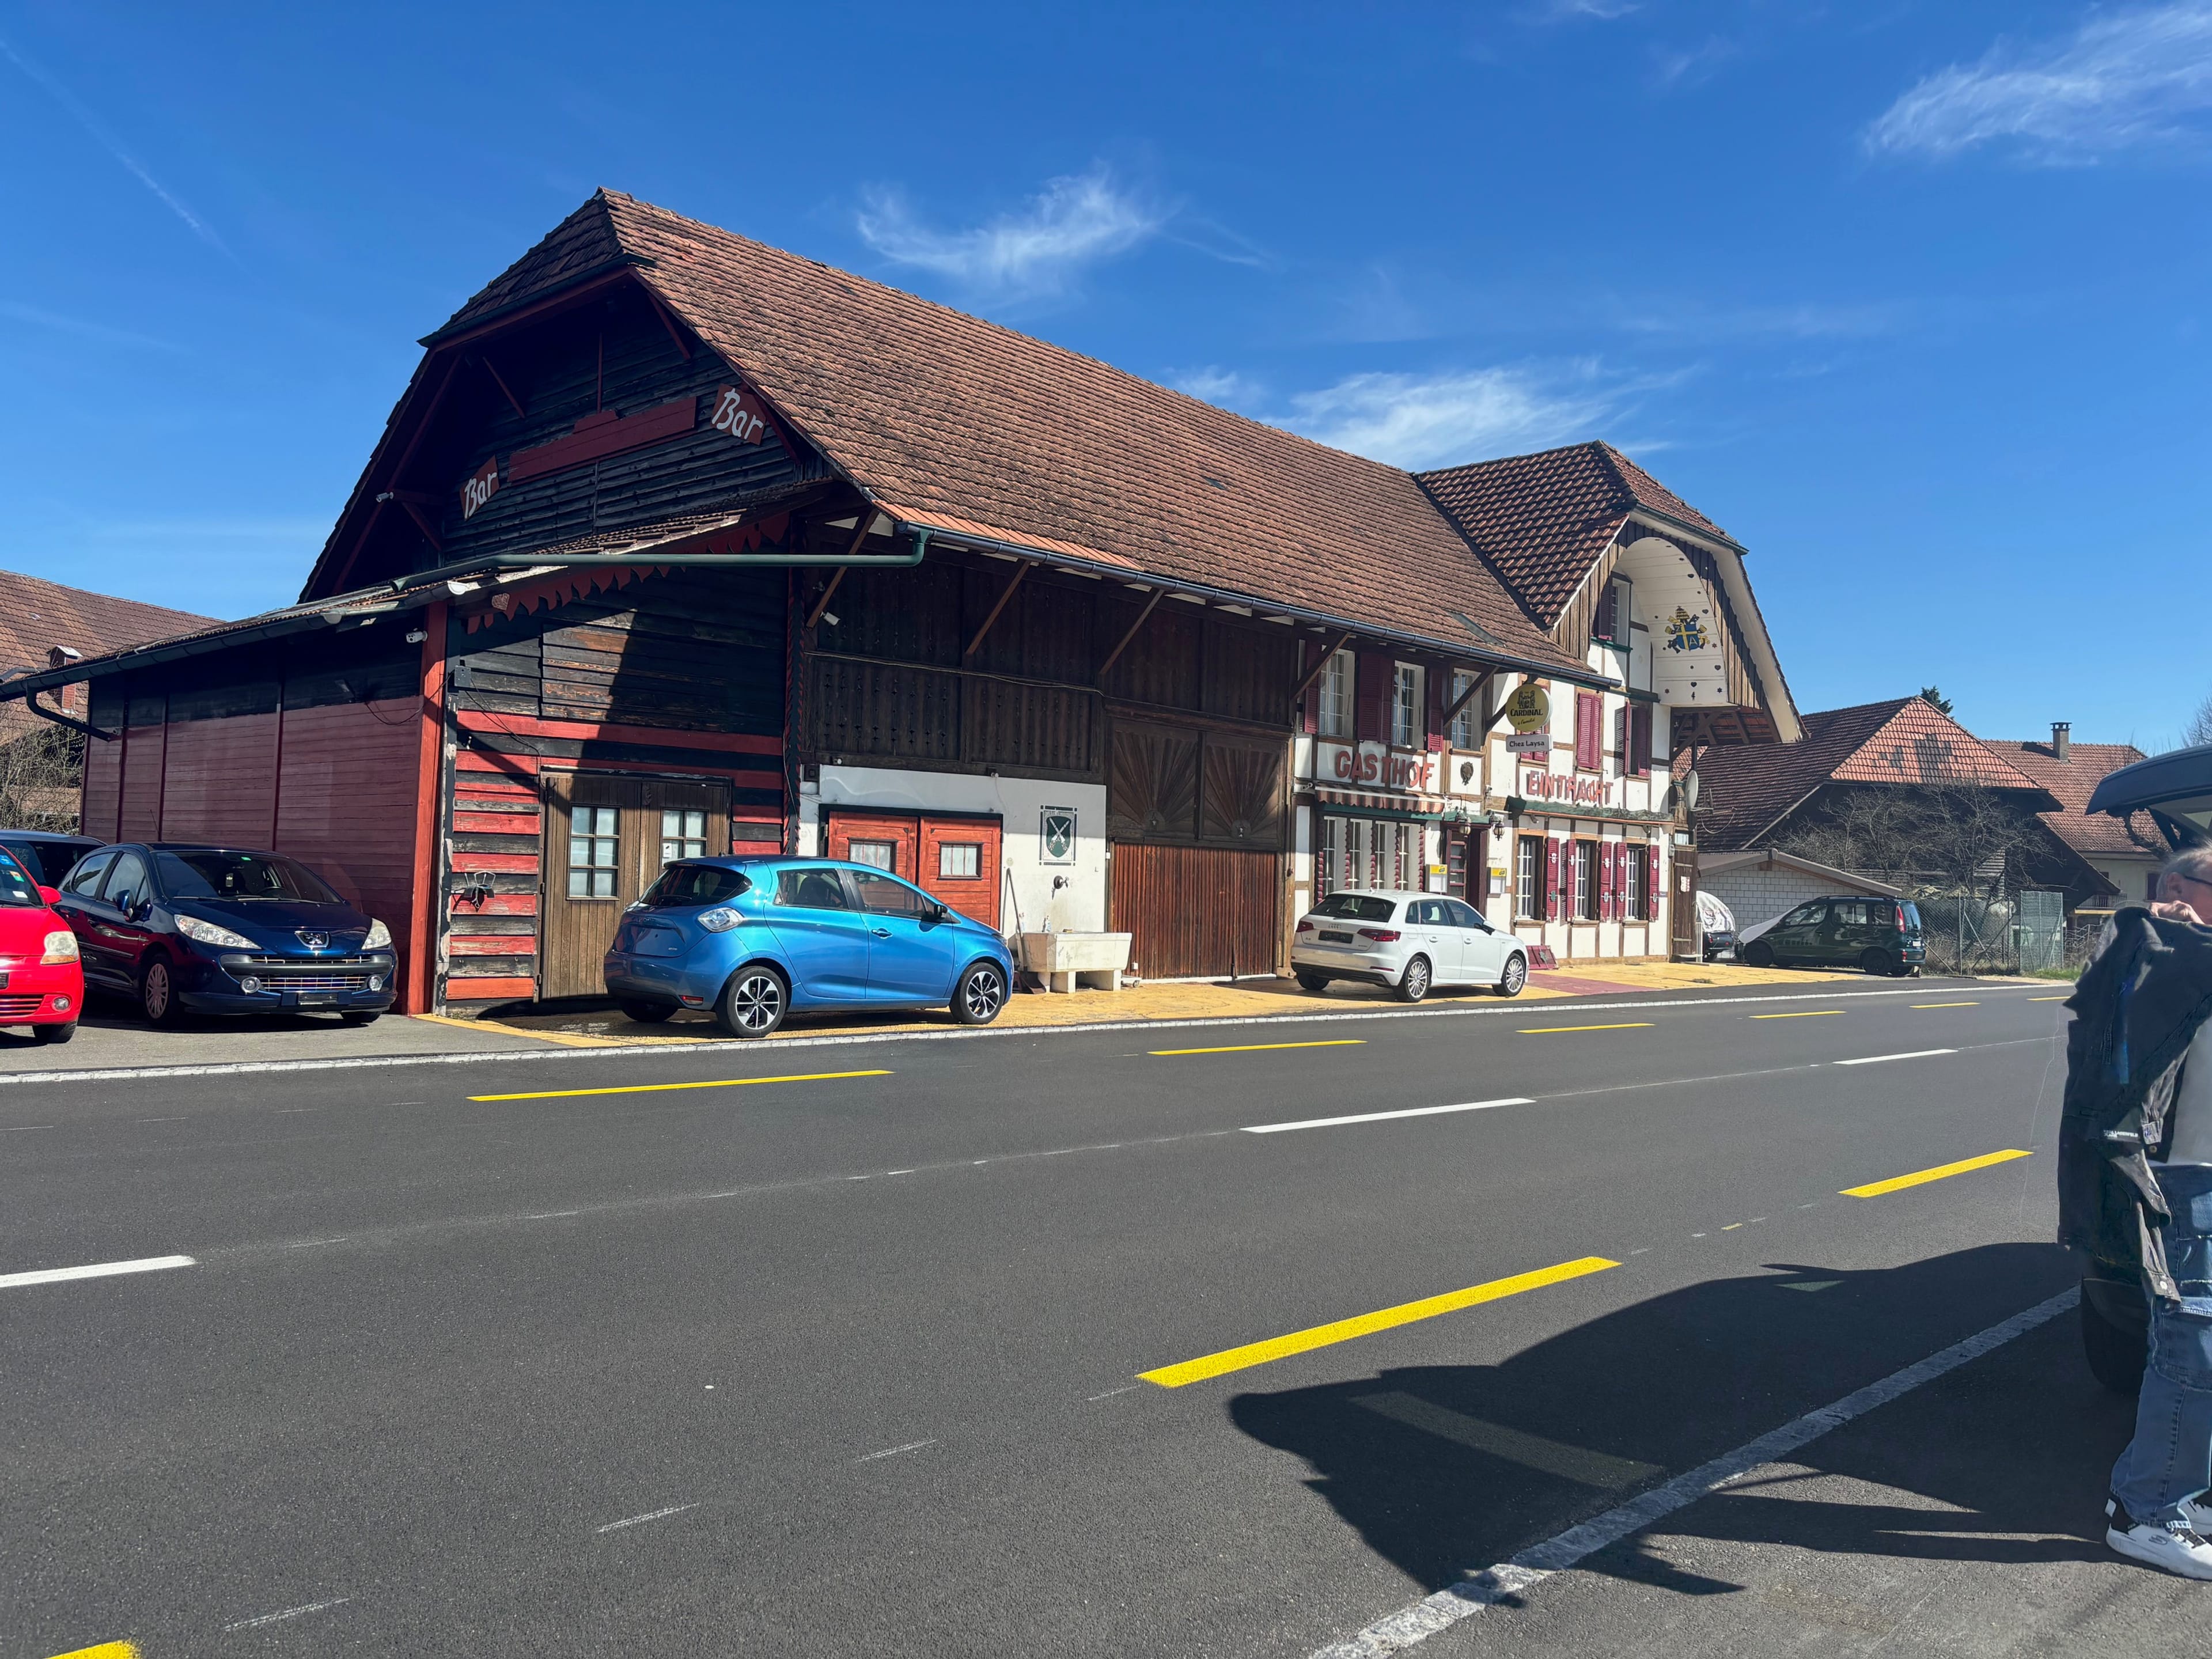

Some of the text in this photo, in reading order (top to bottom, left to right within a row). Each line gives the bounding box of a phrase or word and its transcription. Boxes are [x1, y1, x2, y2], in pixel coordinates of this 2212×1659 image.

[712, 388, 764, 440] Bar
[464, 472, 497, 521] Bar
[1336, 750, 1435, 789] GASTHOF
[1528, 770, 1613, 805] EINTRACHT
